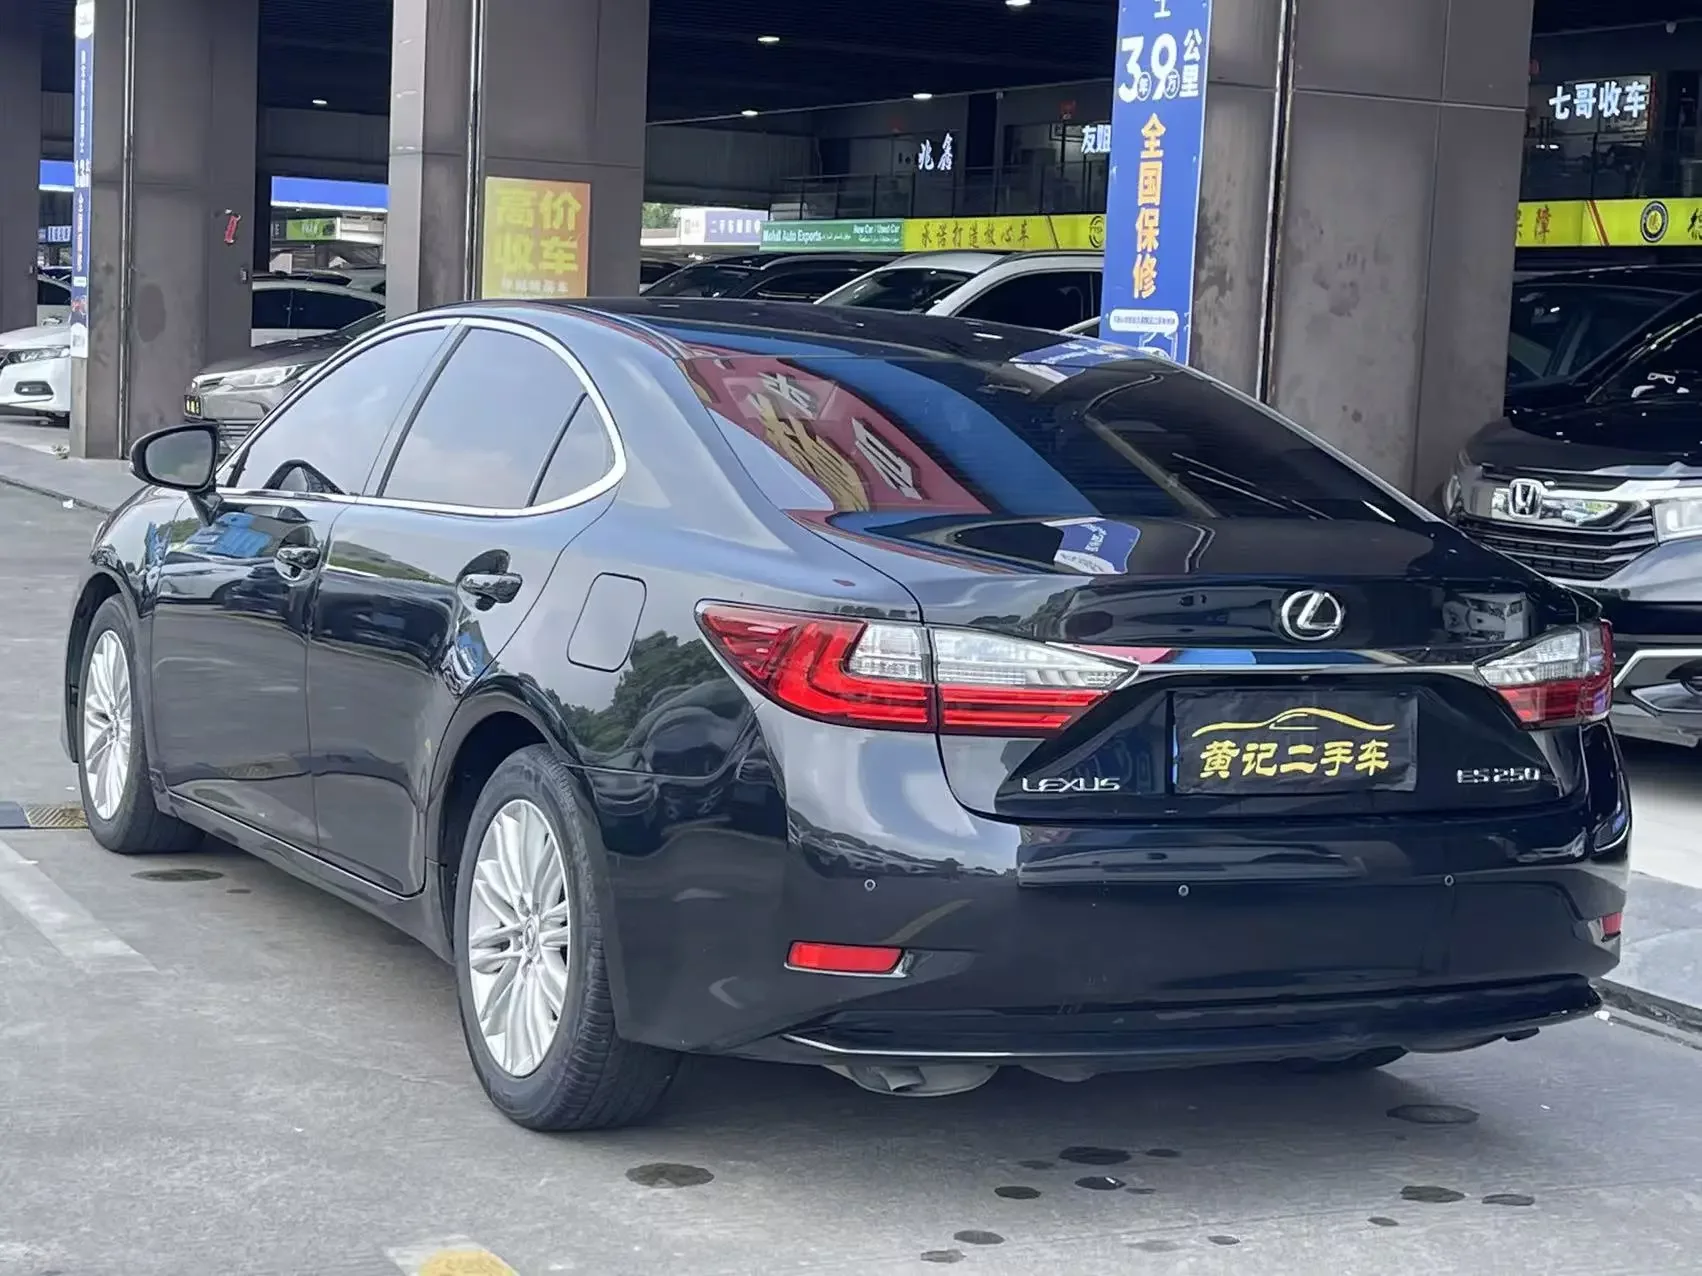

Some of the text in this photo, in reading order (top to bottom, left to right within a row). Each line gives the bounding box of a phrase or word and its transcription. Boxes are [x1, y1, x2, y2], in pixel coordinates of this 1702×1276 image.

[1549, 80, 1647, 120] 七哥收车
[495, 187, 582, 231] 高价
[1132, 112, 1167, 299] 全国保修
[783, 230, 796, 242] Auto
[797, 229, 822, 244] Exports
[865, 224, 874, 234] Car
[891, 223, 901, 233] Car
[493, 233, 580, 275] 收车
[1200, 739, 1390, 779] 黄记二手车
[1022, 777, 1120, 792] LEXUS
